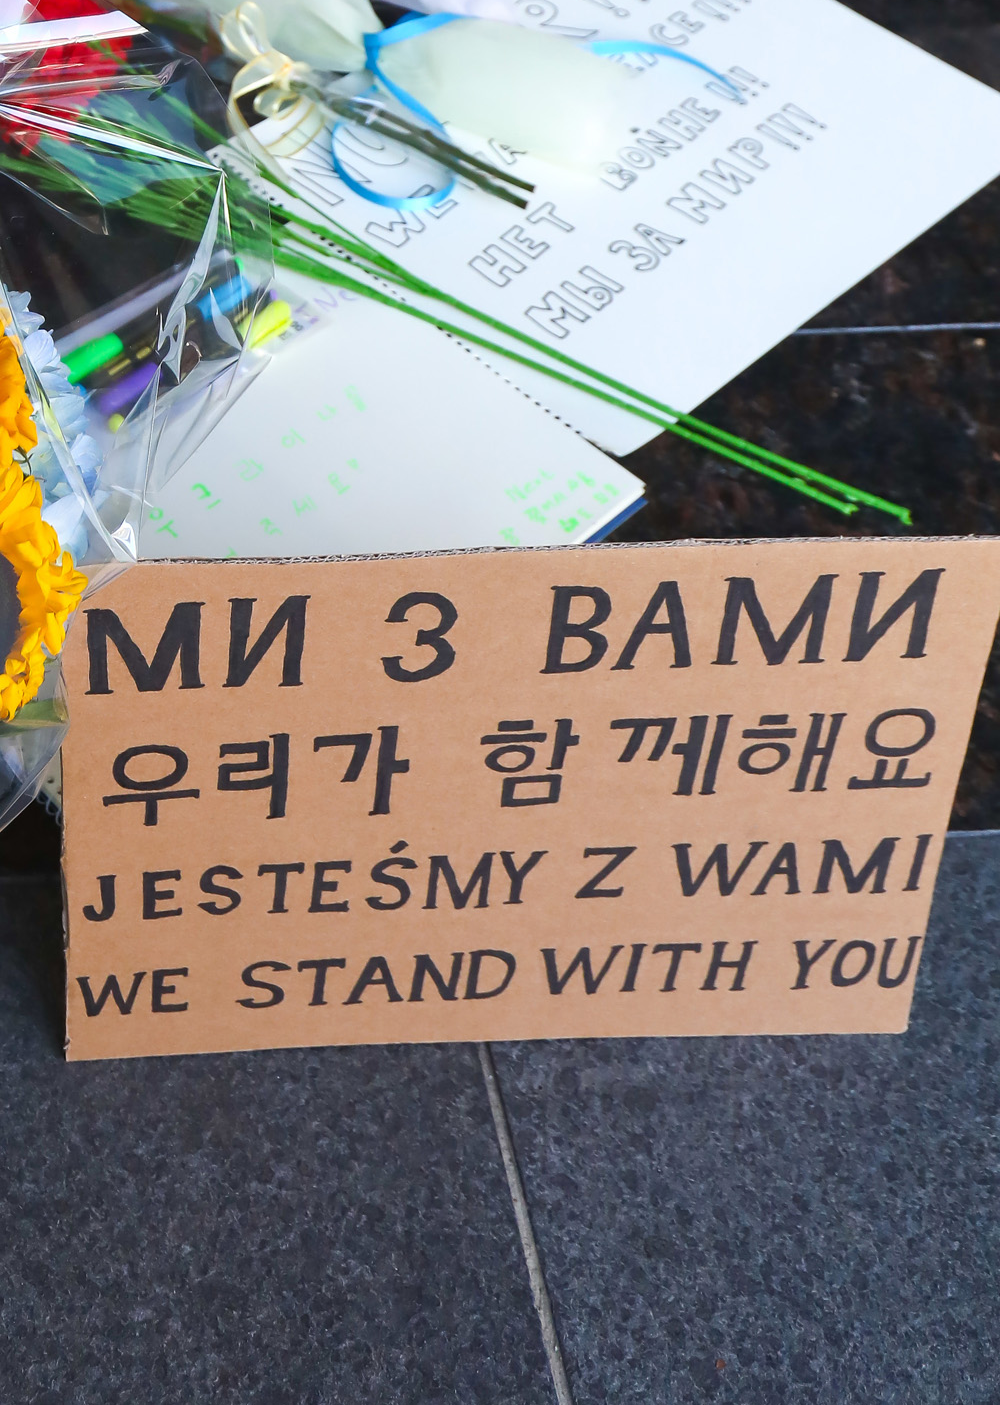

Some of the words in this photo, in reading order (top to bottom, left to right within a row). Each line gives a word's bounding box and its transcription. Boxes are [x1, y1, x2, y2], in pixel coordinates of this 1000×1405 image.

[468, 201, 575, 288] НЕТ
[523, 264, 626, 340] МЫ
[608, 222, 686, 273] ЗА
[83, 594, 311, 697] МИ
[539, 567, 947, 676] ВАМИ
[102, 724, 411, 826] 우리가
[81, 839, 549, 923] JESTEŚMY
[575, 844, 637, 900] Z
[673, 833, 935, 898] WAMI
[75, 966, 190, 1018] WE
[236, 948, 517, 1009] STAND
[539, 939, 753, 996] WITH
[790, 935, 923, 991] YOU
